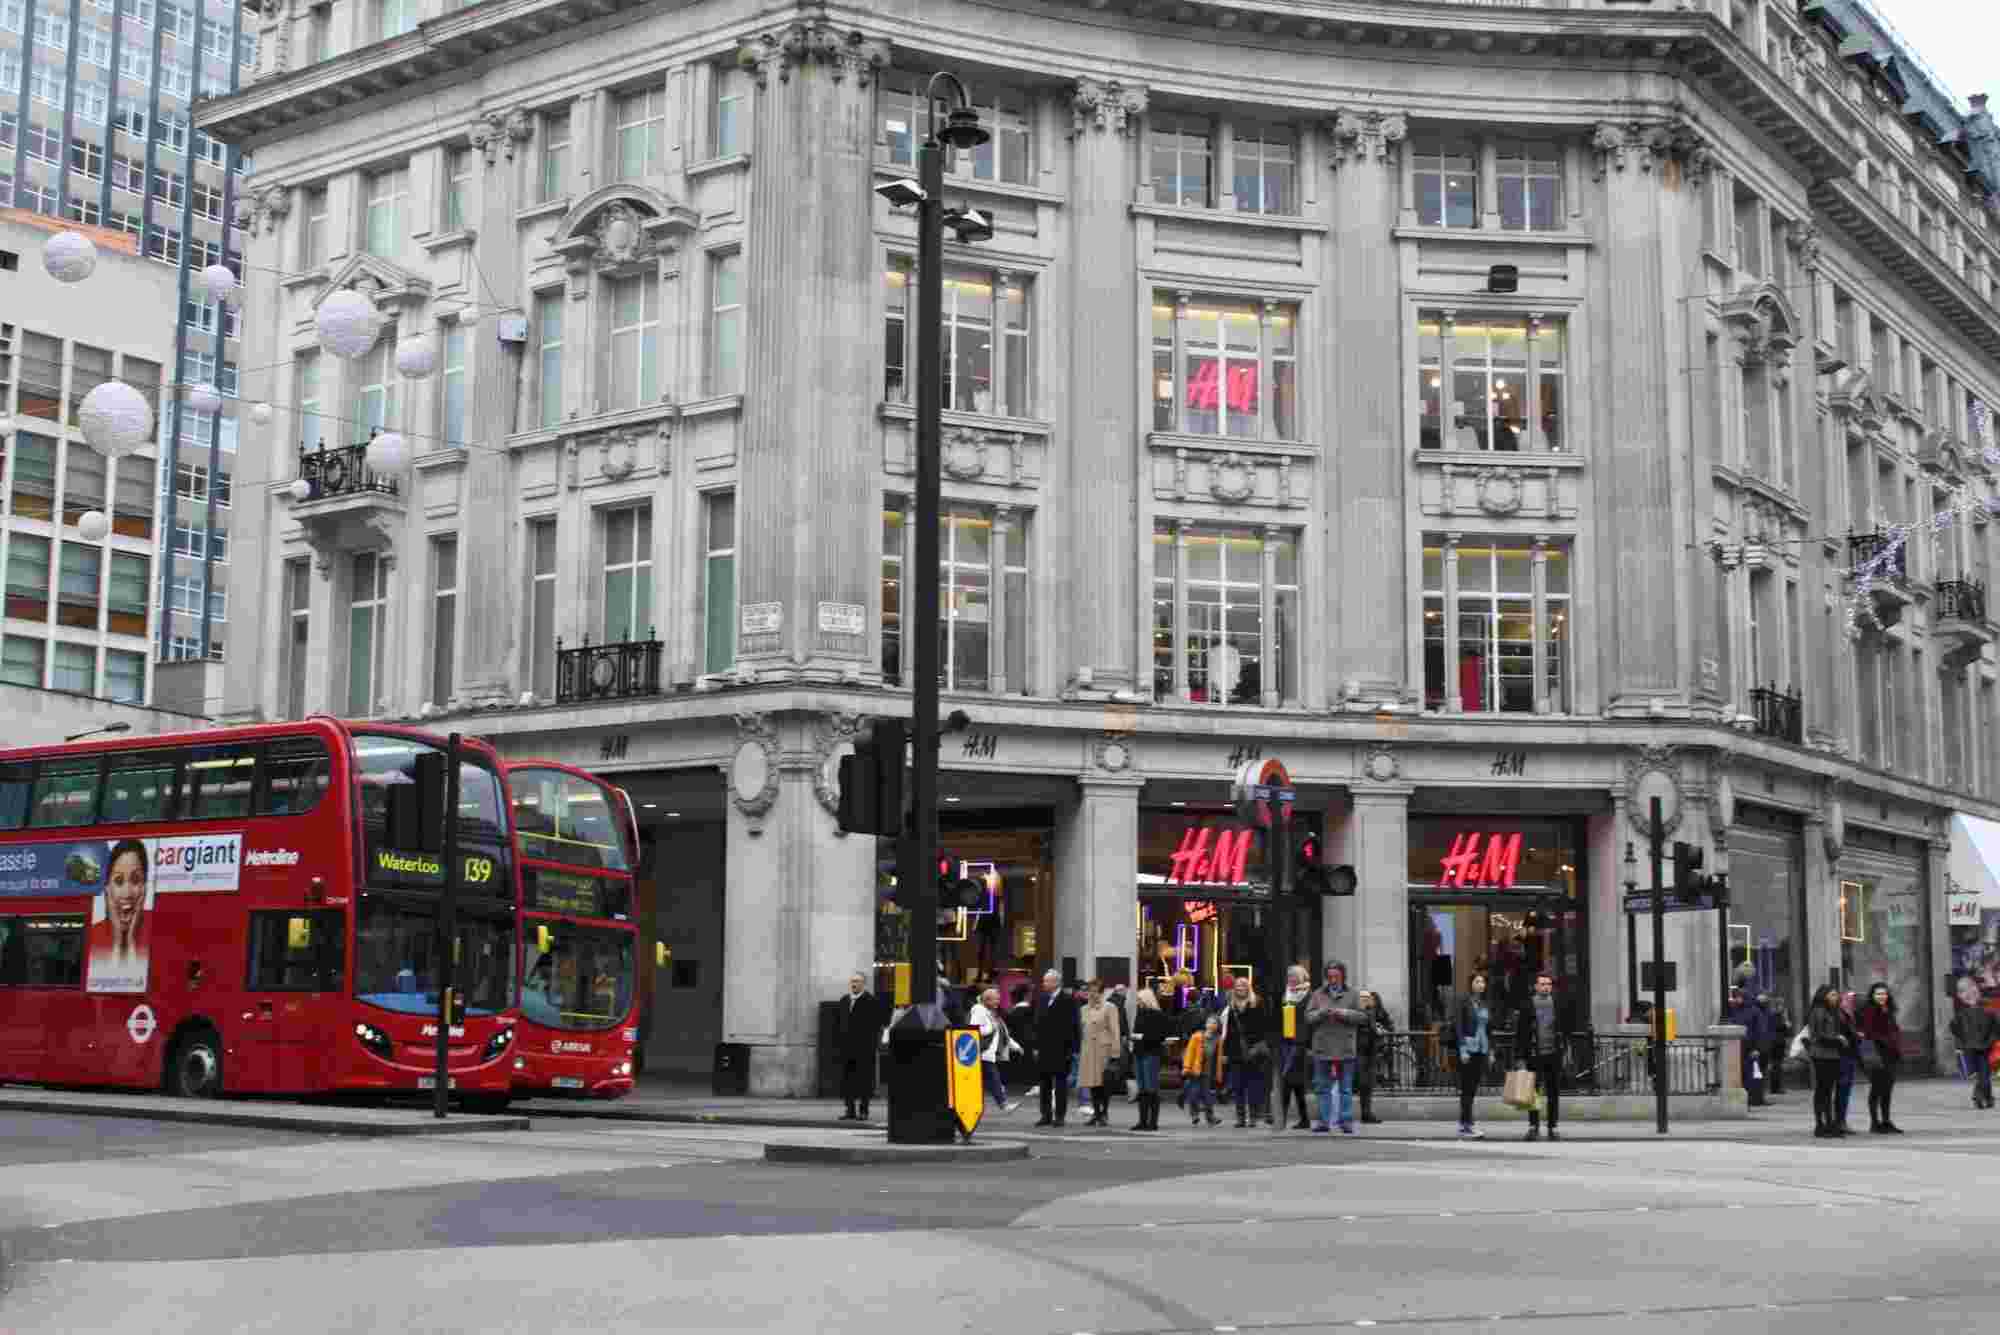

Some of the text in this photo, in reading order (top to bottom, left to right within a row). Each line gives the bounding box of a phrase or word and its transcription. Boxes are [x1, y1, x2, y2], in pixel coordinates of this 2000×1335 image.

[962, 734, 997, 759] H&M
[1490, 751, 1527, 776] H&M
[154, 839, 235, 871] cargiant
[245, 846, 299, 867] Metroline
[378, 852, 440, 874] Waterloo
[1169, 827, 1252, 882] H&M
[1440, 832, 1521, 886] H&M
[464, 857, 492, 882] 139
